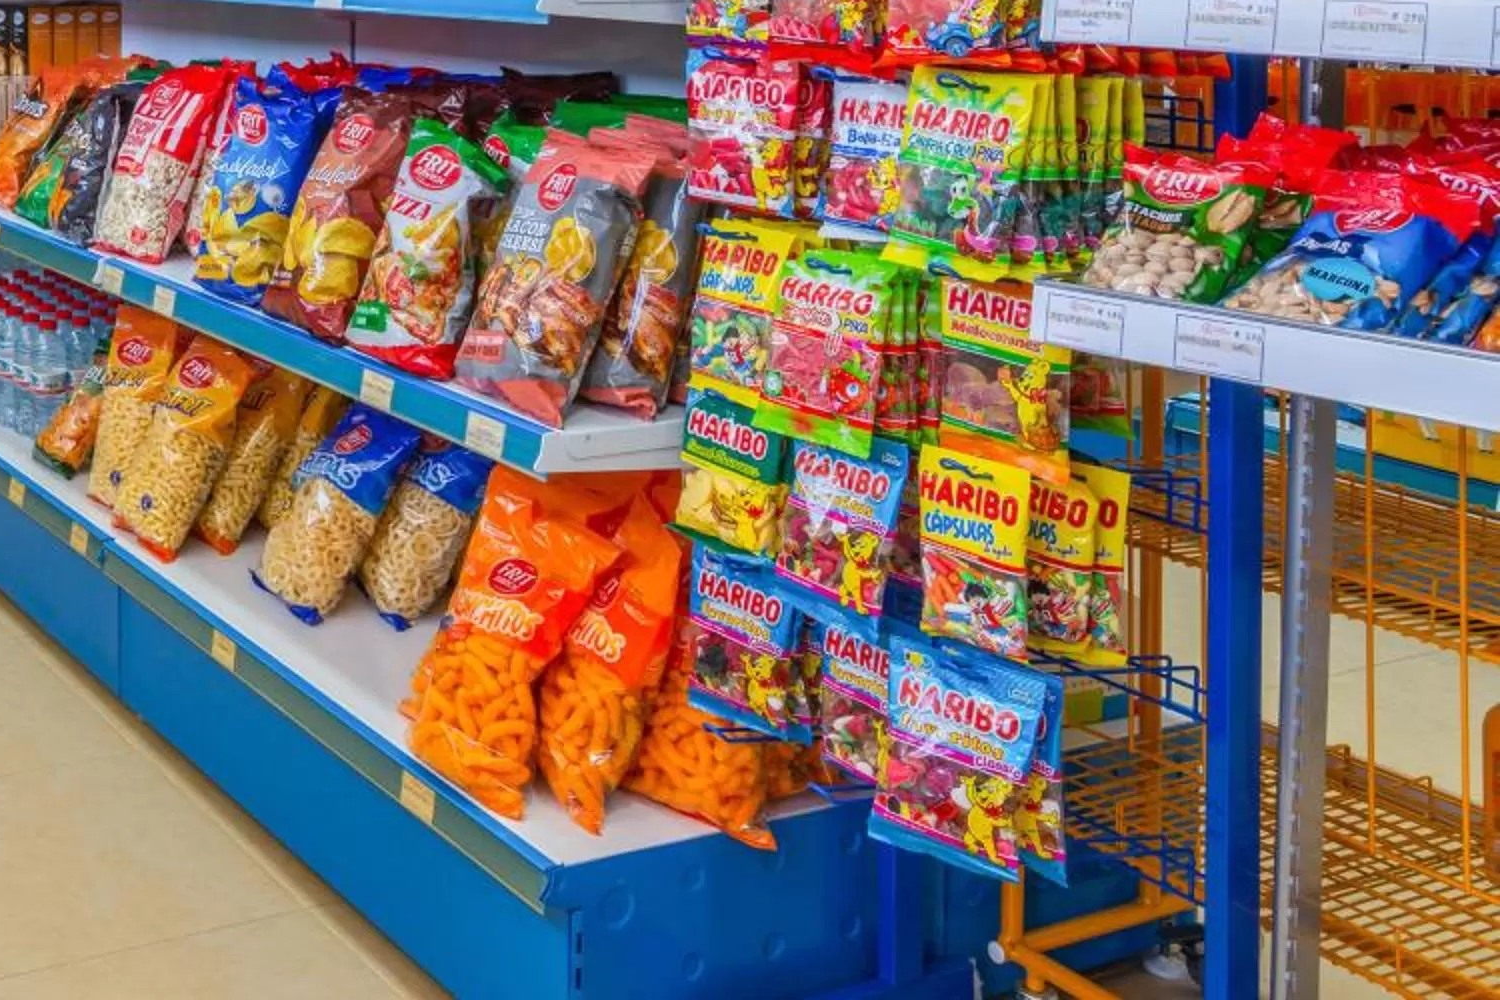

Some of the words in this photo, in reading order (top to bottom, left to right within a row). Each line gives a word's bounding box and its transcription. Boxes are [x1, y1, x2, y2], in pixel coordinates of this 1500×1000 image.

[687, 74, 784, 107] HARIBO
[911, 99, 1012, 144] HARIBO
[417, 150, 461, 178] FRIT
[1152, 168, 1210, 191] FRIT
[703, 237, 779, 277] HARIBO
[780, 275, 876, 318] HARIBO
[948, 286, 1032, 330] HARIB
[687, 408, 768, 461] HARIBO
[794, 449, 891, 502] HARIBO
[920, 470, 1019, 526] HARIBO
[924, 509, 995, 544] CÁPSULAS
[497, 561, 536, 586] FRIT
[699, 570, 781, 624] HARIBO
[898, 677, 1021, 742] HARIBO
